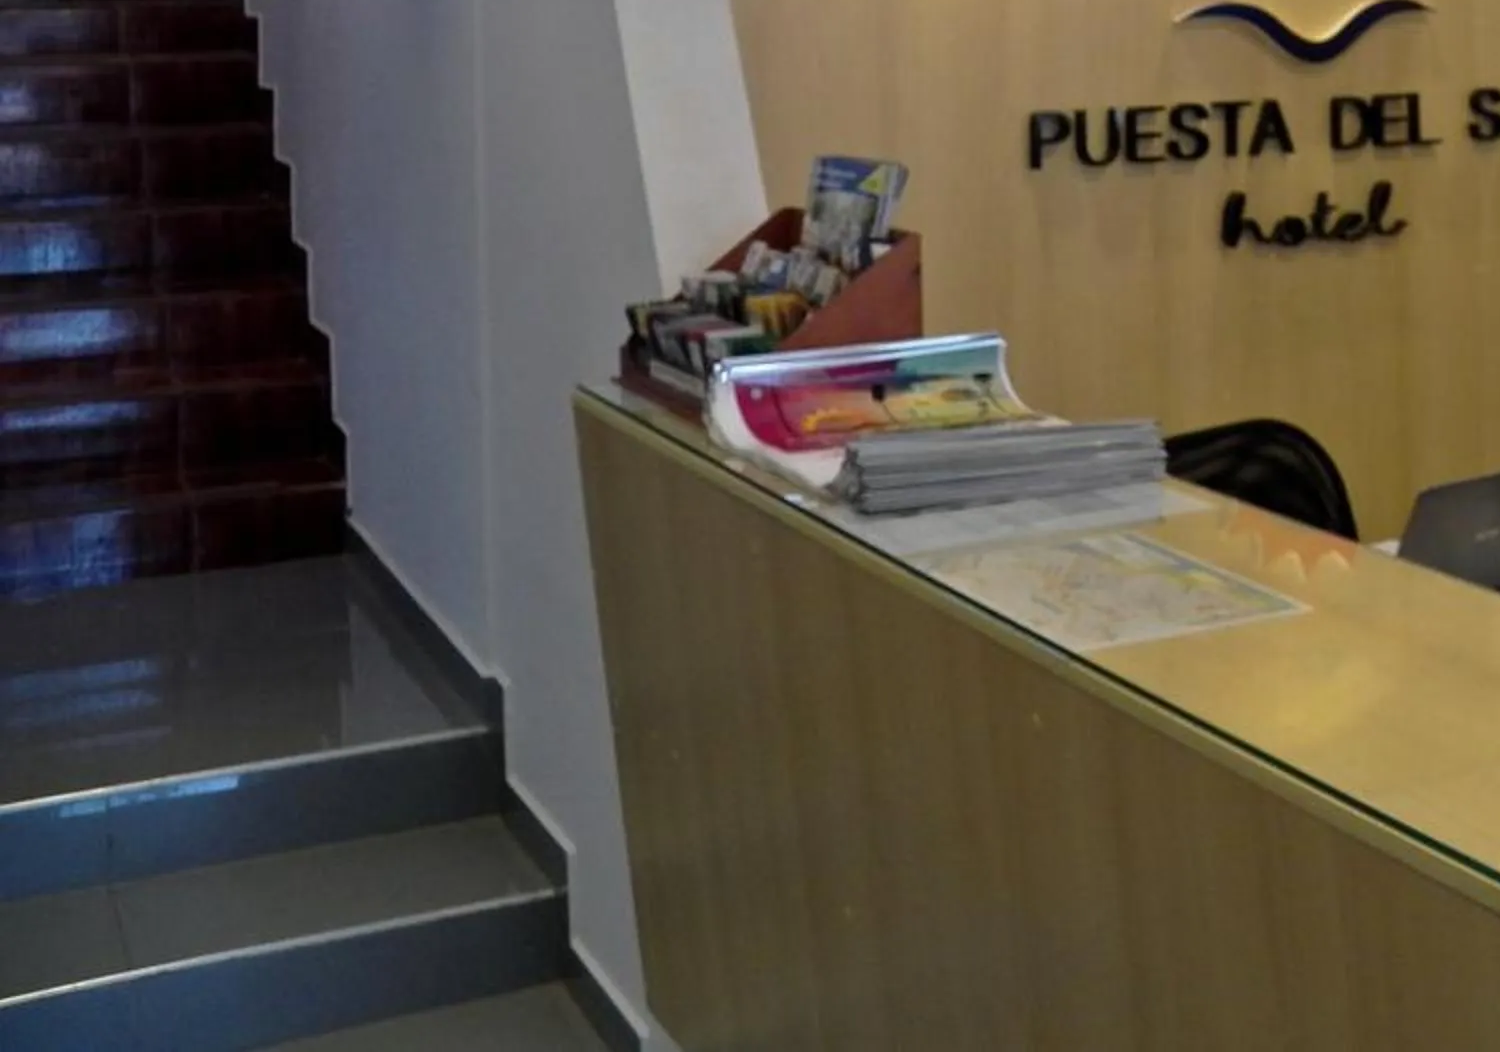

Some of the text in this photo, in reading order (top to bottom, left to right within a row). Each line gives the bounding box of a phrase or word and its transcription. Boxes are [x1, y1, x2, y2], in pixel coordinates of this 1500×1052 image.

[1030, 99, 1293, 168] PUESTA
[1331, 94, 1441, 149] DEL
[1221, 181, 1407, 247] hotel
